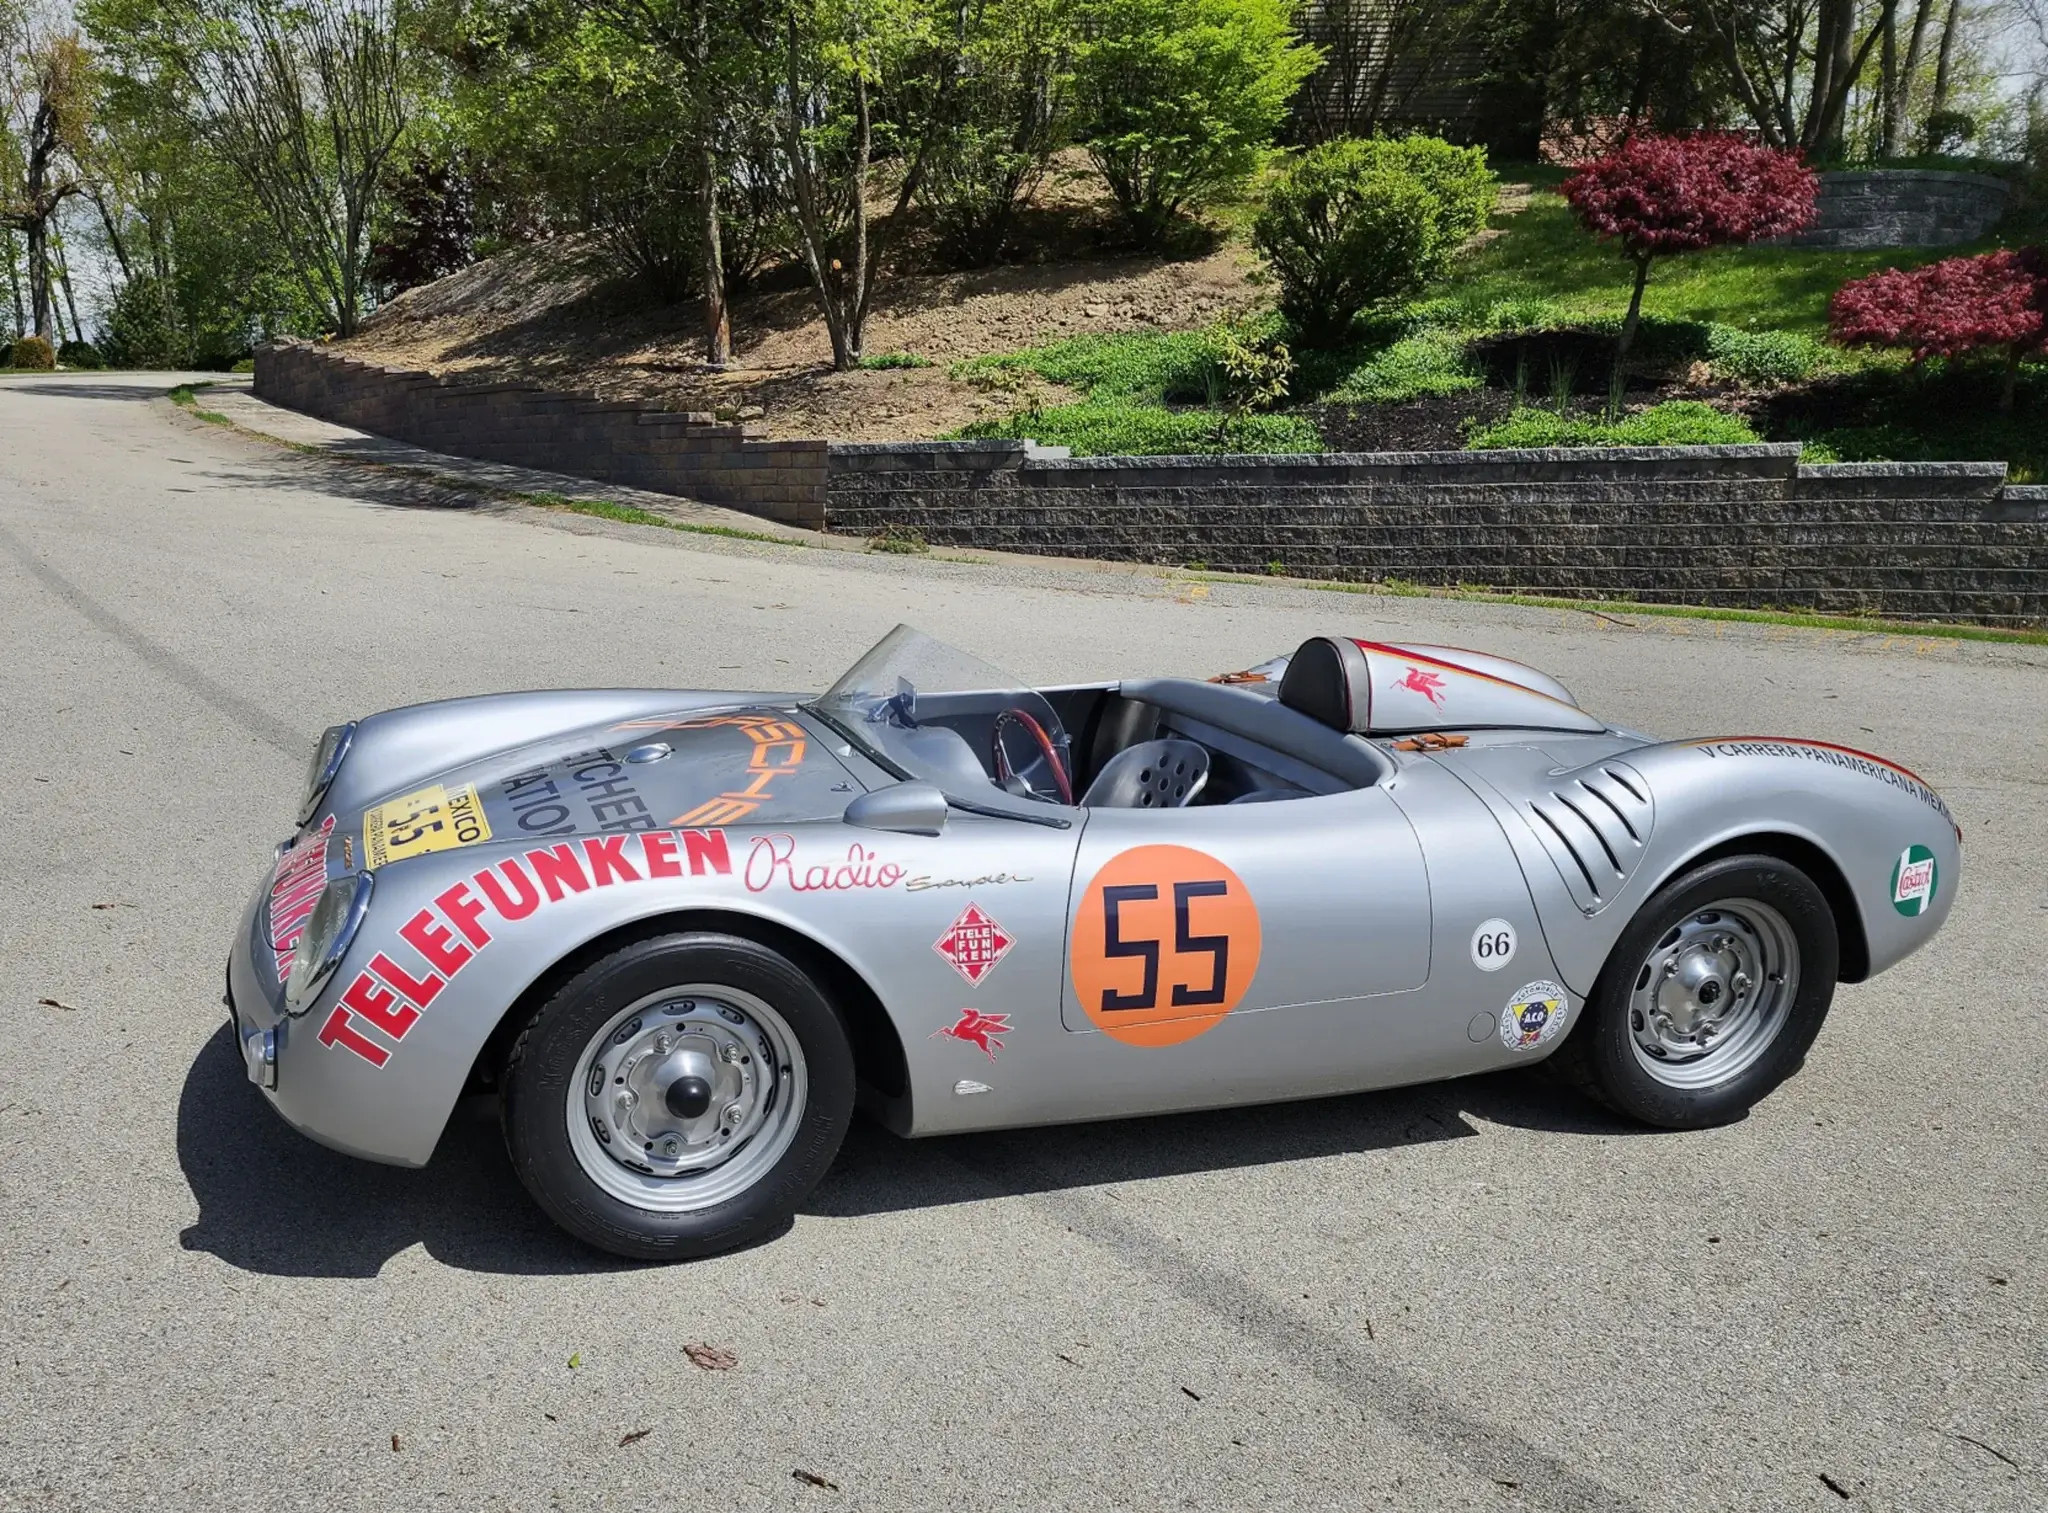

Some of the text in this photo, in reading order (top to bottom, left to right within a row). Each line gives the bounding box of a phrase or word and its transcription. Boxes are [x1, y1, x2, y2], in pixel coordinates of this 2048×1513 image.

[1697, 745, 1716, 759] V
[1717, 744, 1803, 760] CARRERA
[1801, 746, 1918, 799] PANAMERICANA
[387, 804, 444, 847] 55
[744, 831, 908, 893] Radio
[316, 827, 733, 1071] TELEFUNKEN
[957, 927, 990, 940] TELE
[957, 938, 991, 951] FUN
[1100, 879, 1229, 1013] 55
[1477, 931, 1510, 958] 66
[958, 949, 992, 962] KEN
